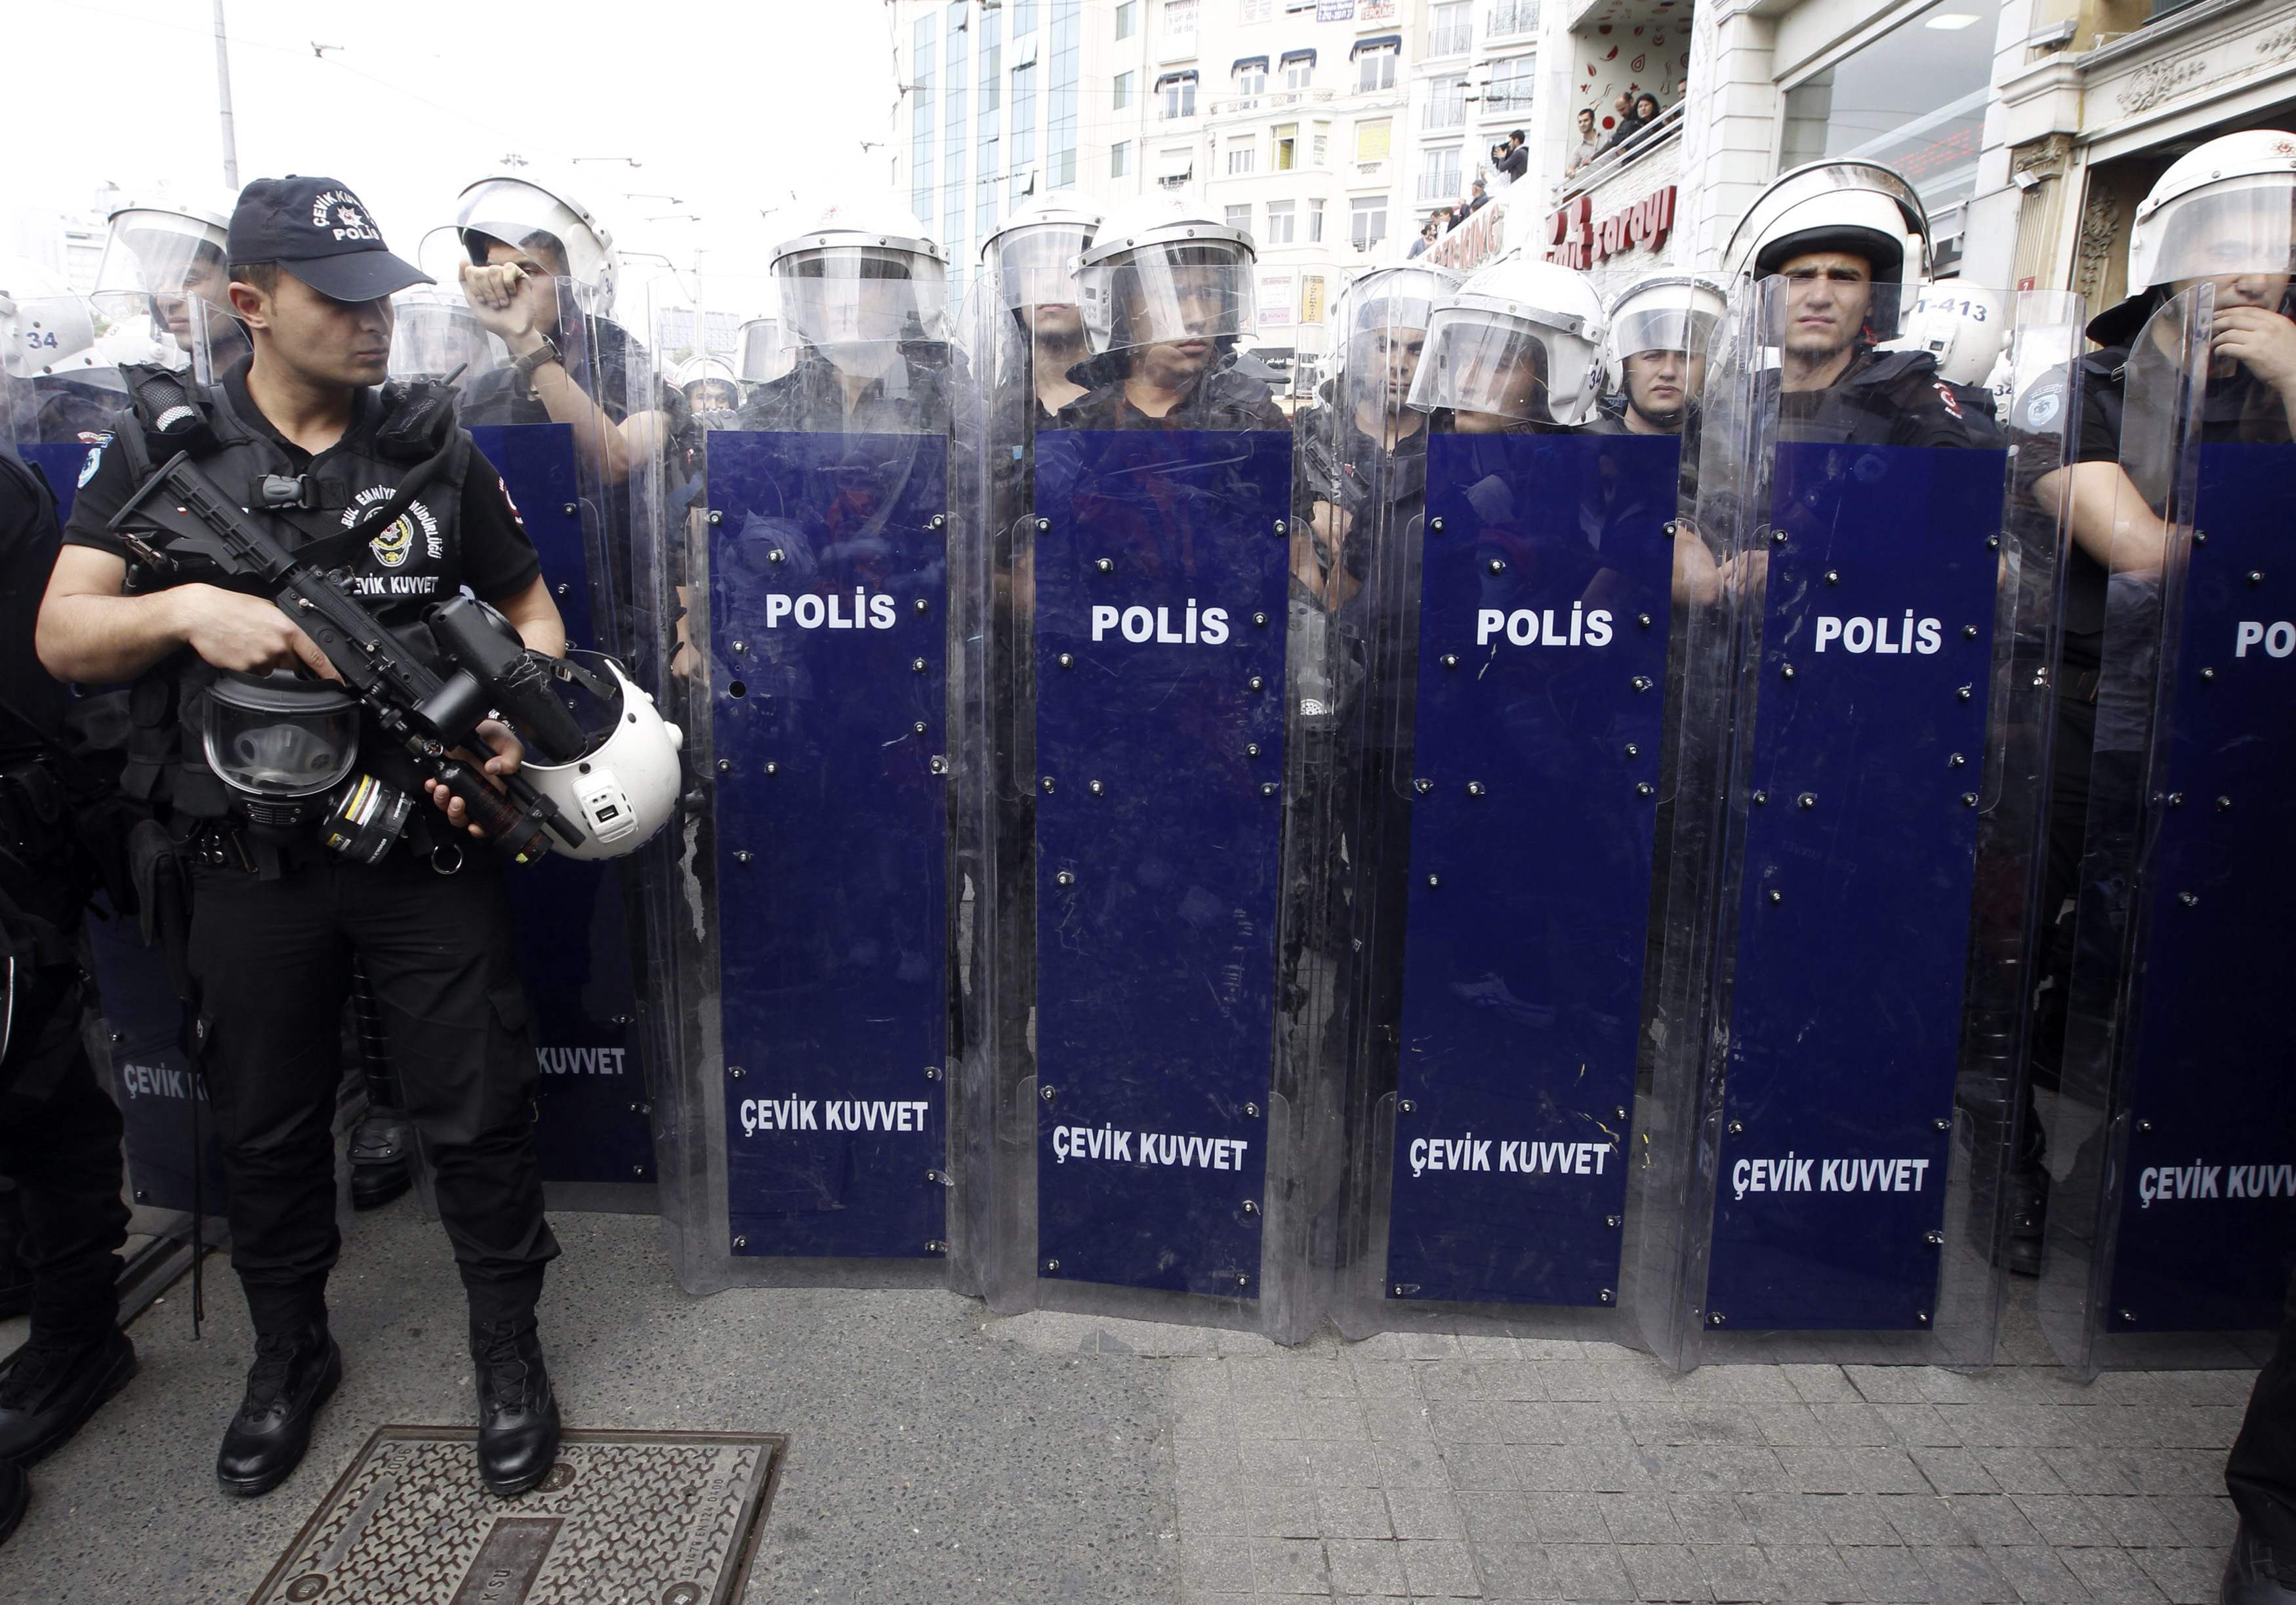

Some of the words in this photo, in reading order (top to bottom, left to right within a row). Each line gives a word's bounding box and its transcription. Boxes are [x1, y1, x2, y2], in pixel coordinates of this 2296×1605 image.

[313, 191, 338, 227] ÇEVİK
[333, 224, 380, 241] POLİS
[1460, 203, 1503, 270] KING
[1540, 196, 1593, 270] imit
[27, 331, 58, 349] 34
[1589, 365, 1603, 390] 34
[341, 506, 360, 529] BUL
[355, 484, 397, 506] EMNİYE
[353, 572, 386, 595] EVİK
[390, 576, 439, 594] KUVVET
[766, 586, 896, 629] POLİS
[1092, 598, 1229, 645] POLİS
[1477, 600, 1613, 647] POLİS
[1815, 609, 1942, 655] POLİS
[123, 1061, 184, 1099] ÇEVİK
[535, 1047, 625, 1074] KUVVET
[740, 1093, 818, 1137] ÇEVİK
[825, 1101, 928, 1131] KUVVET
[1053, 1122, 1132, 1164] ÇEVİK
[1139, 1132, 1248, 1171] KUVVET
[1410, 1132, 1492, 1178] ÇEVİK
[1499, 1141, 1614, 1175] KUVVET
[1732, 1151, 1814, 1200] ÇEVİK
[1820, 1159, 1929, 1192] KUVVET
[2139, 1158, 2221, 1209] ÇEVİK
[383, 1448, 412, 1476] 2006
